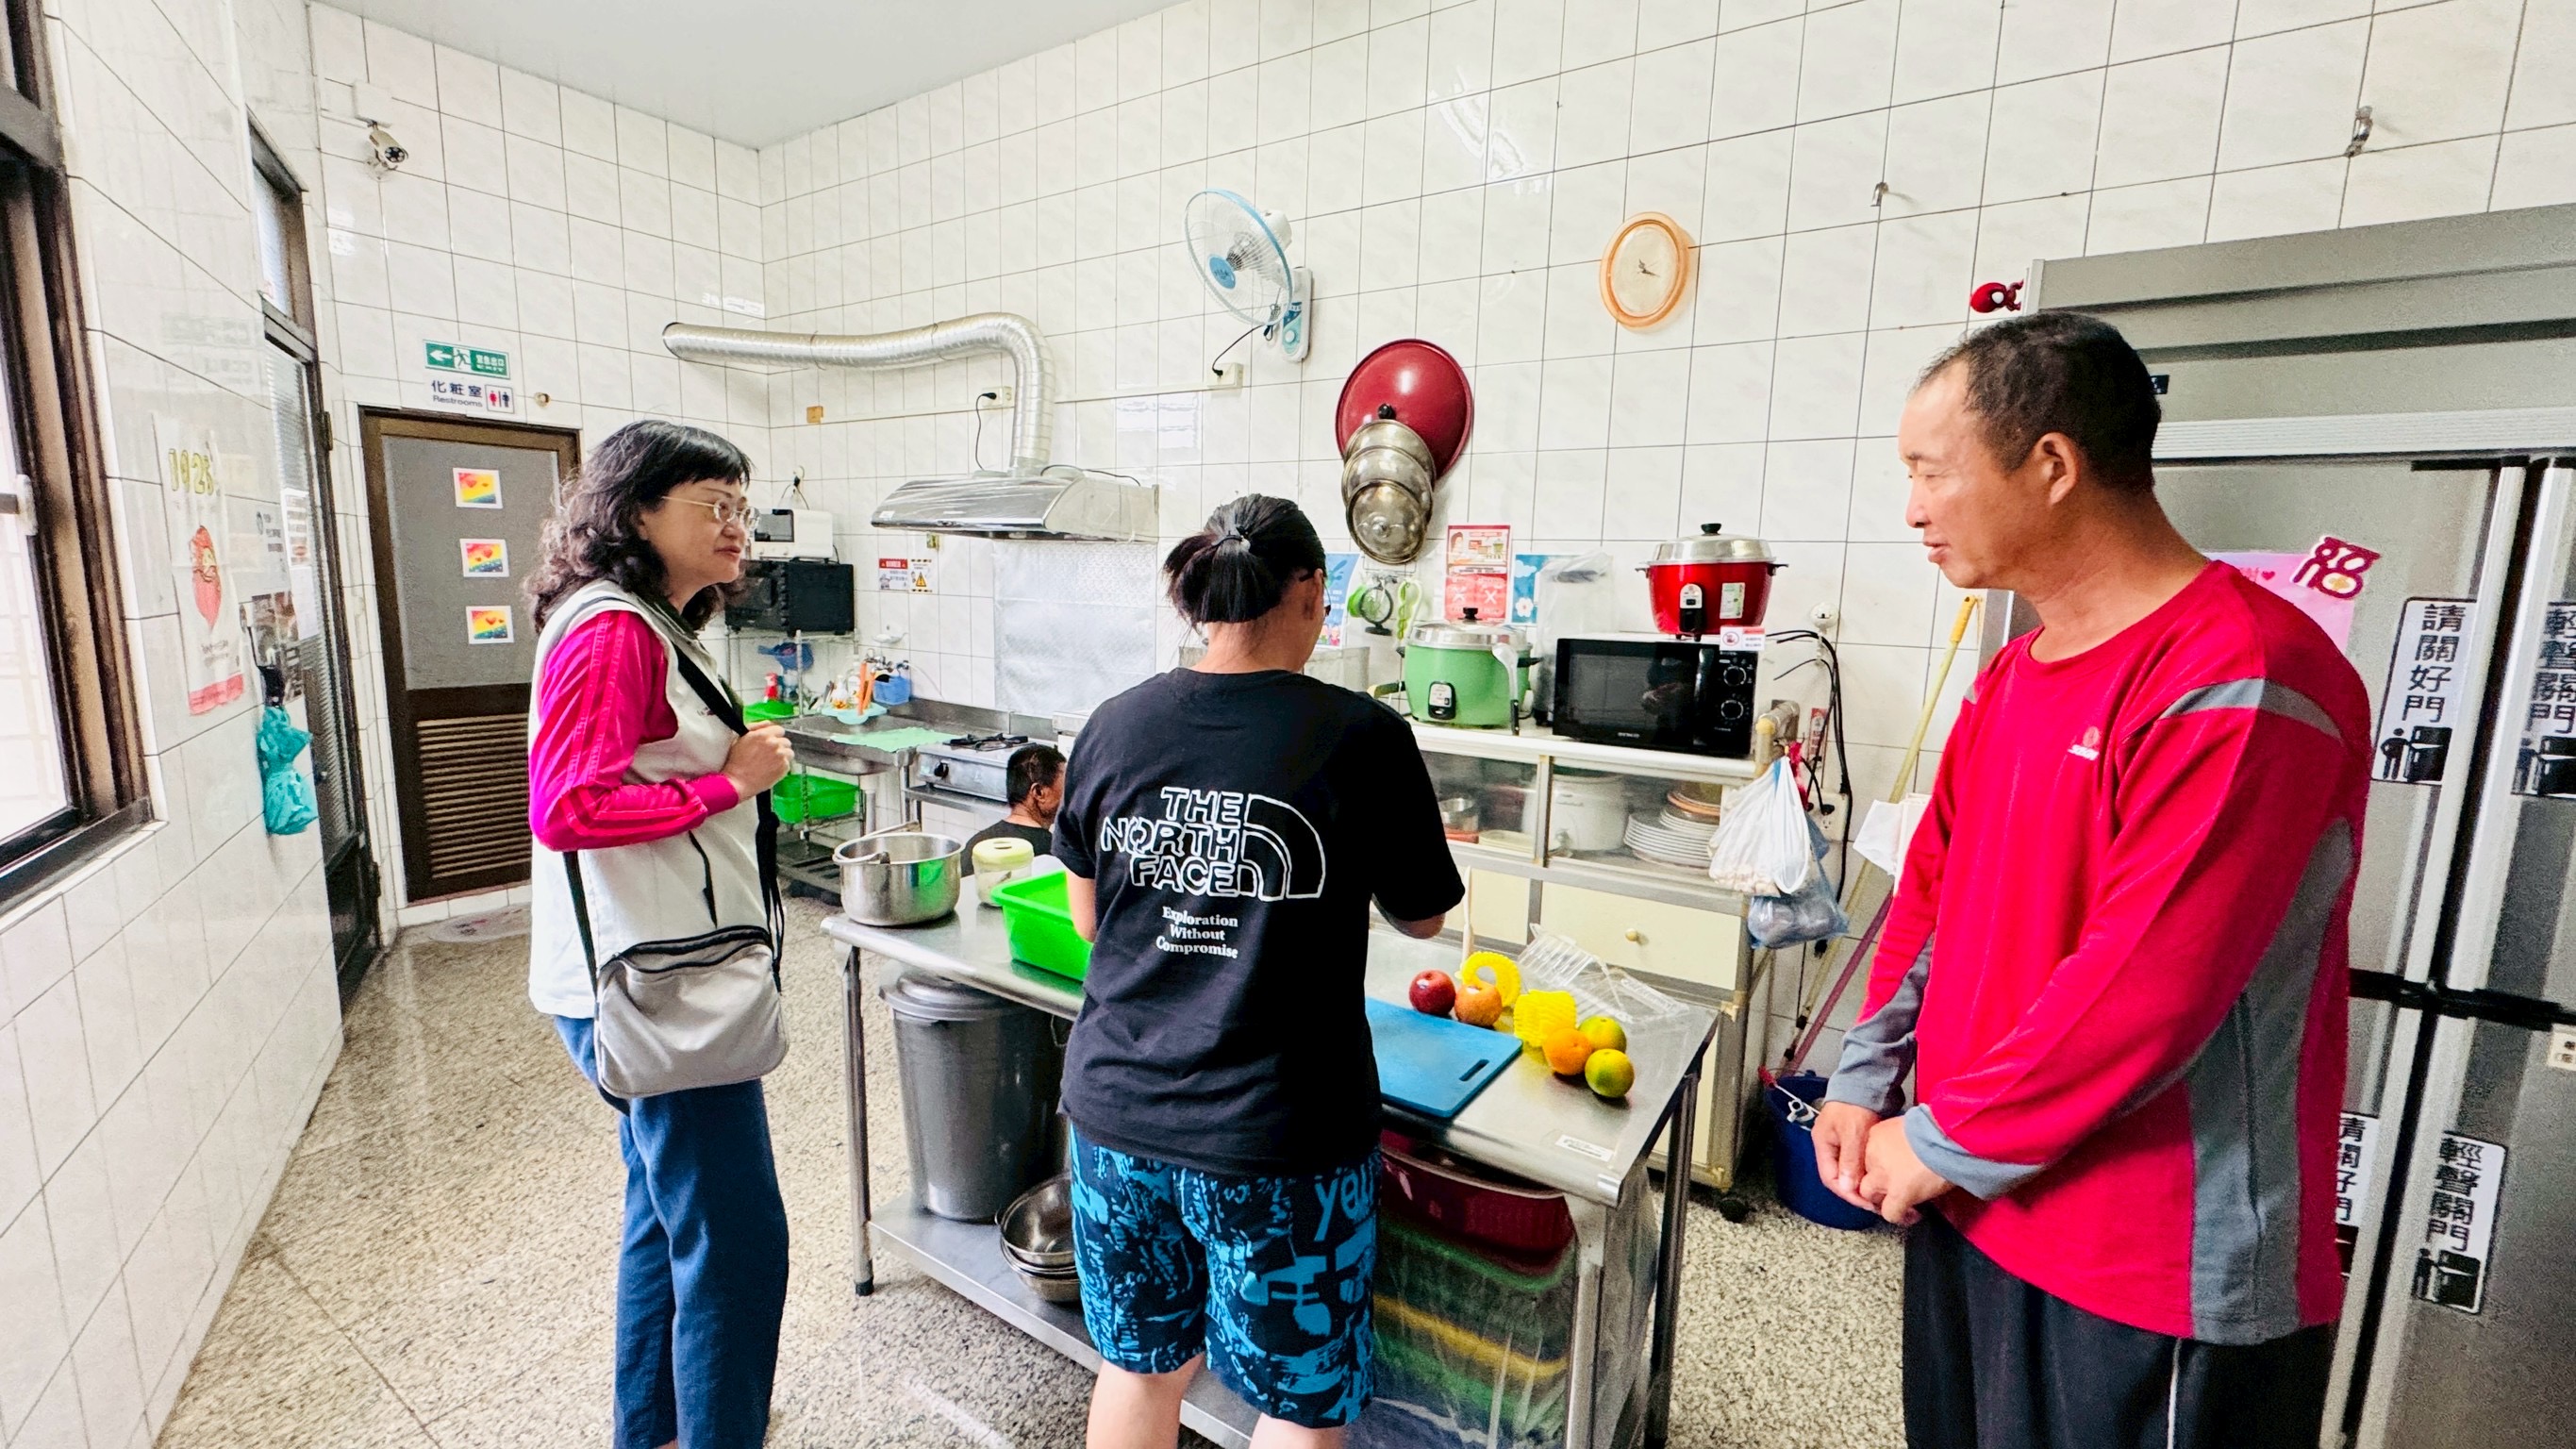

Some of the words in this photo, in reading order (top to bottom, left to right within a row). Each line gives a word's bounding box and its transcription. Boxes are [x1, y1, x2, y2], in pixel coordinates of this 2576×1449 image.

[431, 380, 483, 398] 化粧室
[433, 395, 483, 407] Restrooms
[2401, 604, 2466, 724] 請關好門
[1161, 786, 1243, 829] THE
[1100, 816, 1240, 864] NORTH
[1130, 853, 1241, 897] FACE
[1162, 906, 1238, 927] Exploration
[1170, 924, 1225, 941] Without
[1155, 936, 1238, 958] Compromise
[2425, 1138, 2485, 1253] 輕聲關門
